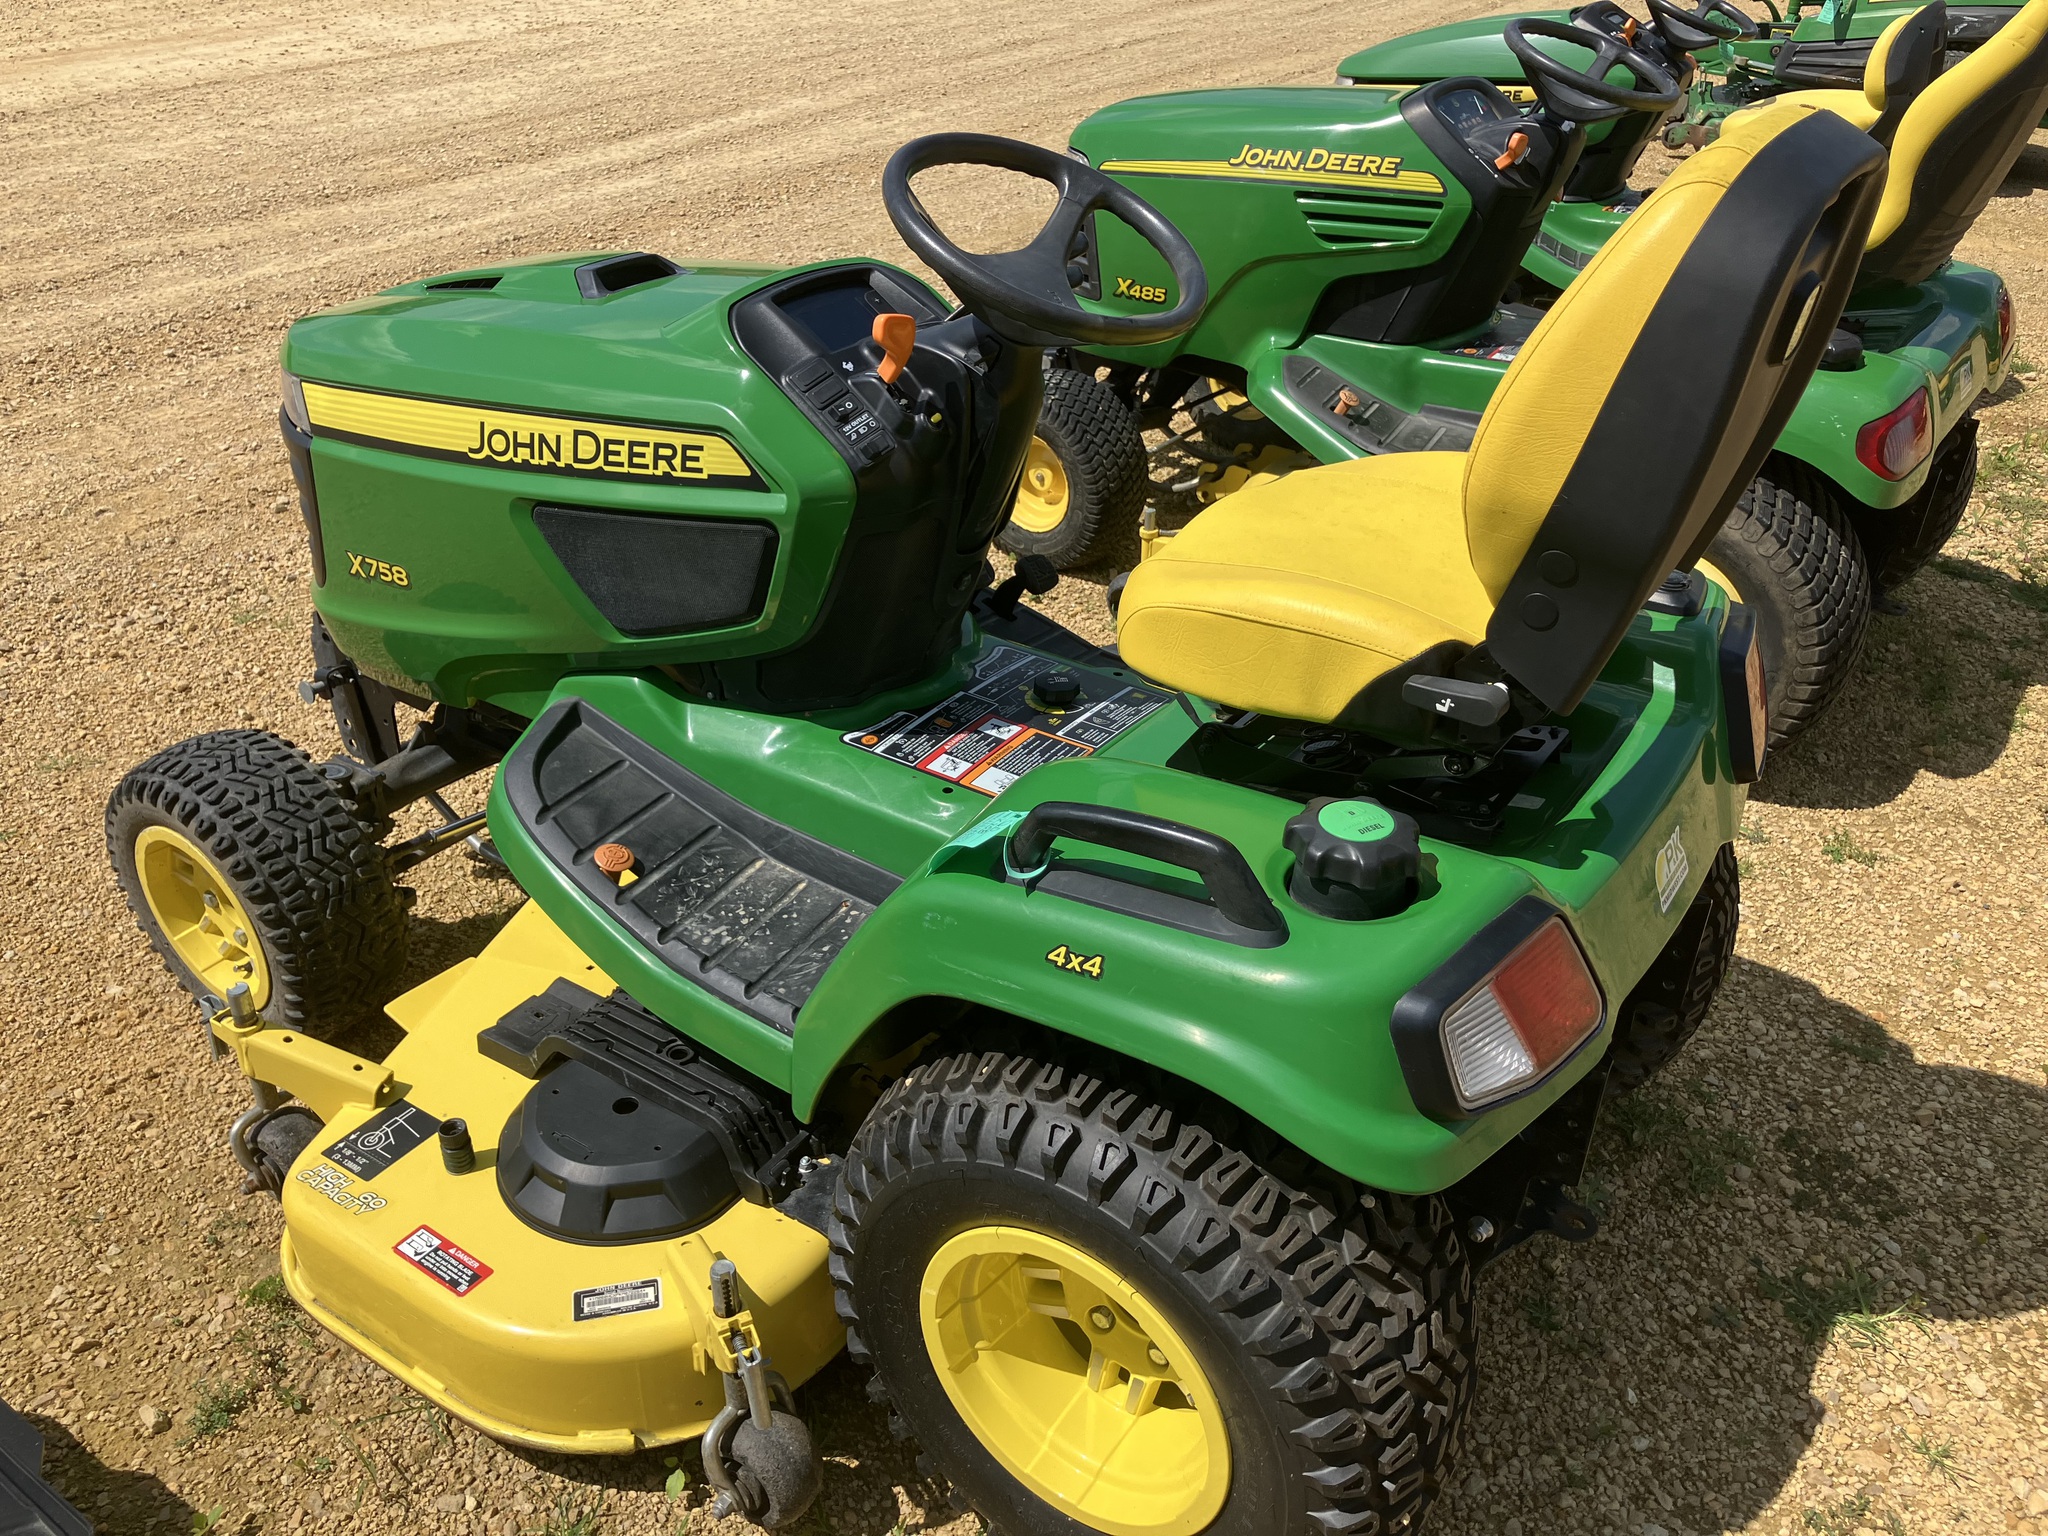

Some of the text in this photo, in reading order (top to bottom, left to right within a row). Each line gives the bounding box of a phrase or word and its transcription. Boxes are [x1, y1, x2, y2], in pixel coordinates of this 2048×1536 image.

[1229, 144, 1403, 176] JOHN DEERE
[1114, 277, 1167, 303] X485
[852, 414, 869, 426] OUTLET
[467, 421, 705, 476] JOHN DEERE
[346, 550, 410, 589] X758
[1358, 823, 1385, 834] DIESEL
[1046, 945, 1104, 978] 4x4
[295, 1169, 376, 1216] CAPACITY
[311, 1163, 388, 1211] HIGH 60
[436, 1250, 473, 1275] ROTATING BLADE
[454, 1251, 480, 1268] DANGER
